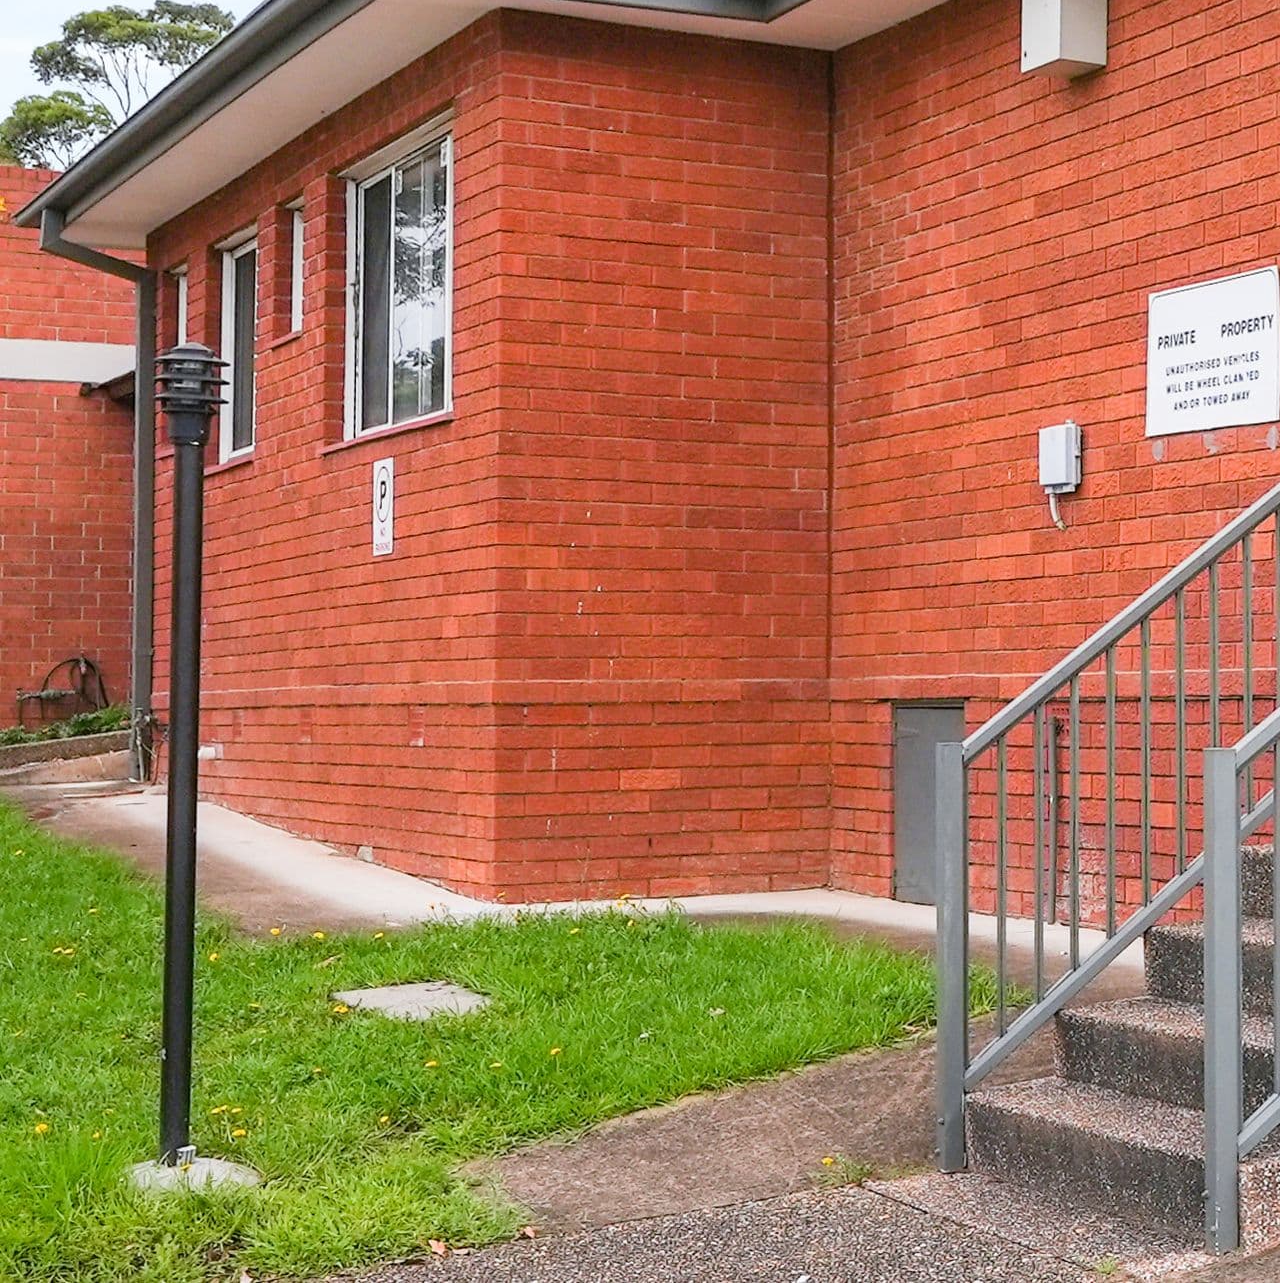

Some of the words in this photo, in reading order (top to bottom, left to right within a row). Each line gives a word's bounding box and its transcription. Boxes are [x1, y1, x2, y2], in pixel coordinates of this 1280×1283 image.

[1157, 329, 1196, 350] PRIVATE
[1220, 314, 1274, 337] PROPERTY
[1165, 357, 1221, 377] UNAUTHORISED
[1166, 382, 1182, 394] WILL
[1184, 380, 1194, 392] BE
[1197, 376, 1221, 389] WHEEL
[1203, 393, 1229, 407] TOWED
[1231, 390, 1251, 402] AWAY
